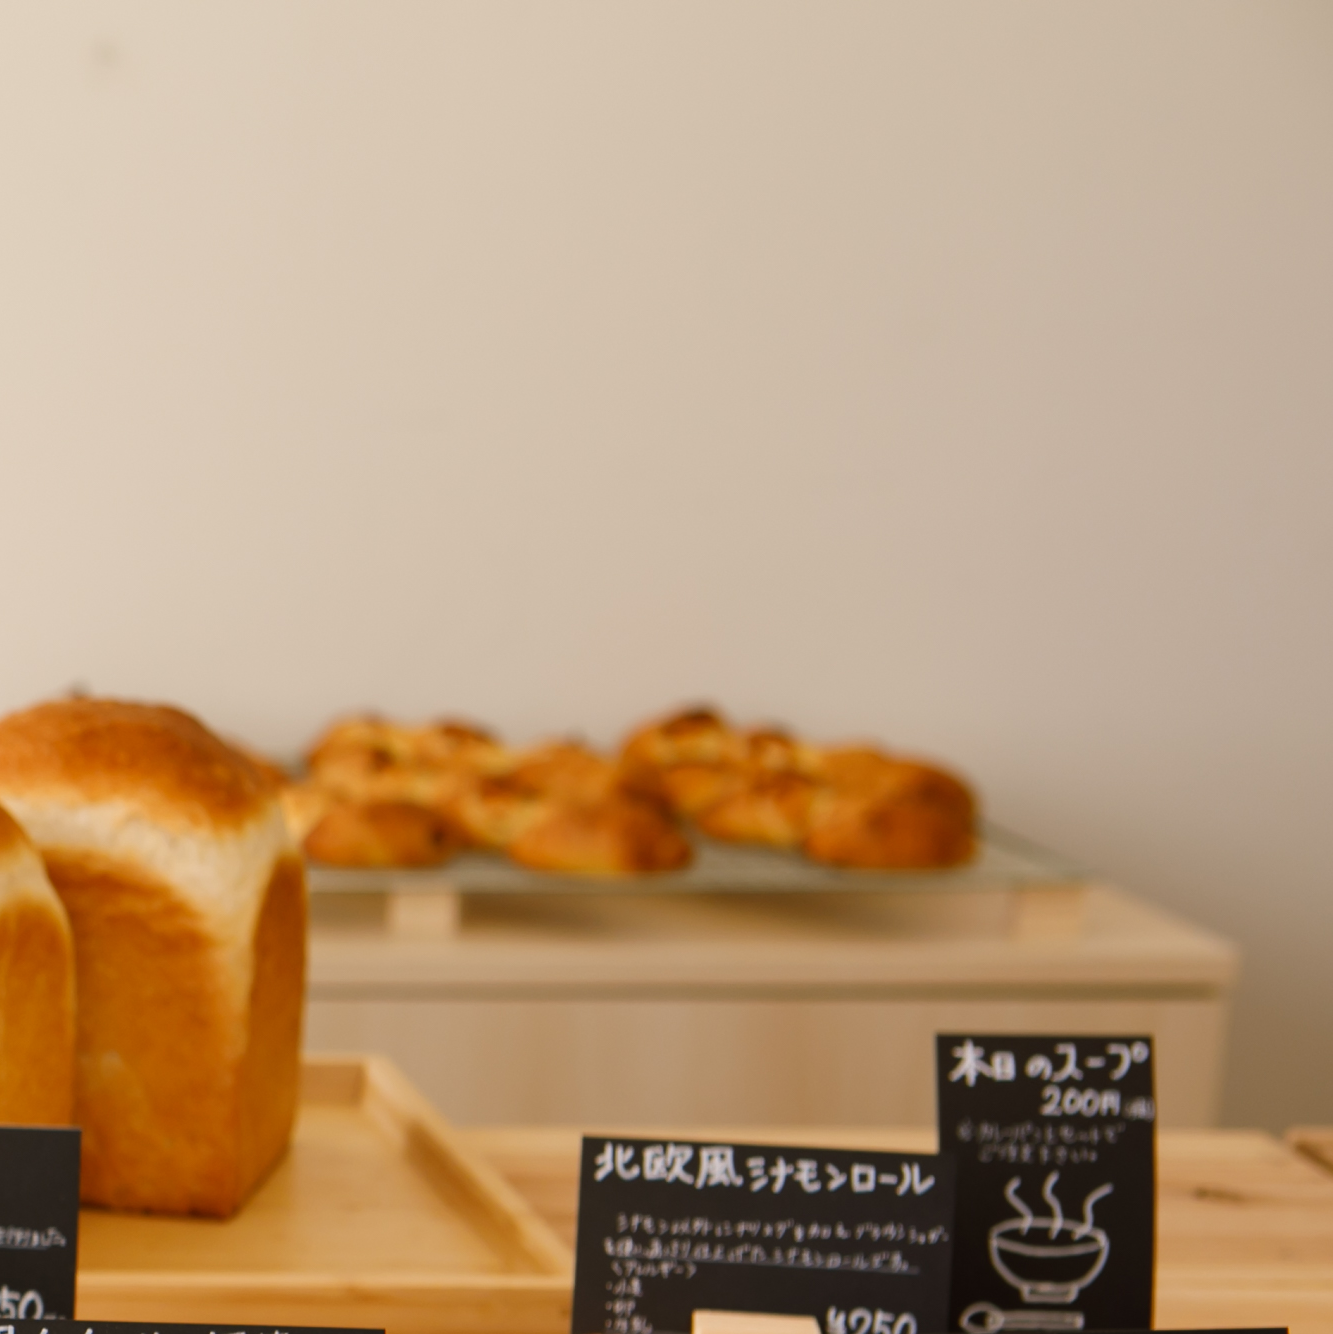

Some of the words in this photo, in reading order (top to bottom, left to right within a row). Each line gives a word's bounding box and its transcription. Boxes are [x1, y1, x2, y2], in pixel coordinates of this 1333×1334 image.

[948, 1038, 1150, 1087] 本日のスープ
[1040, 1084, 1121, 1118] 200円
[593, 1142, 936, 1198] 北欧風シナモンロール
